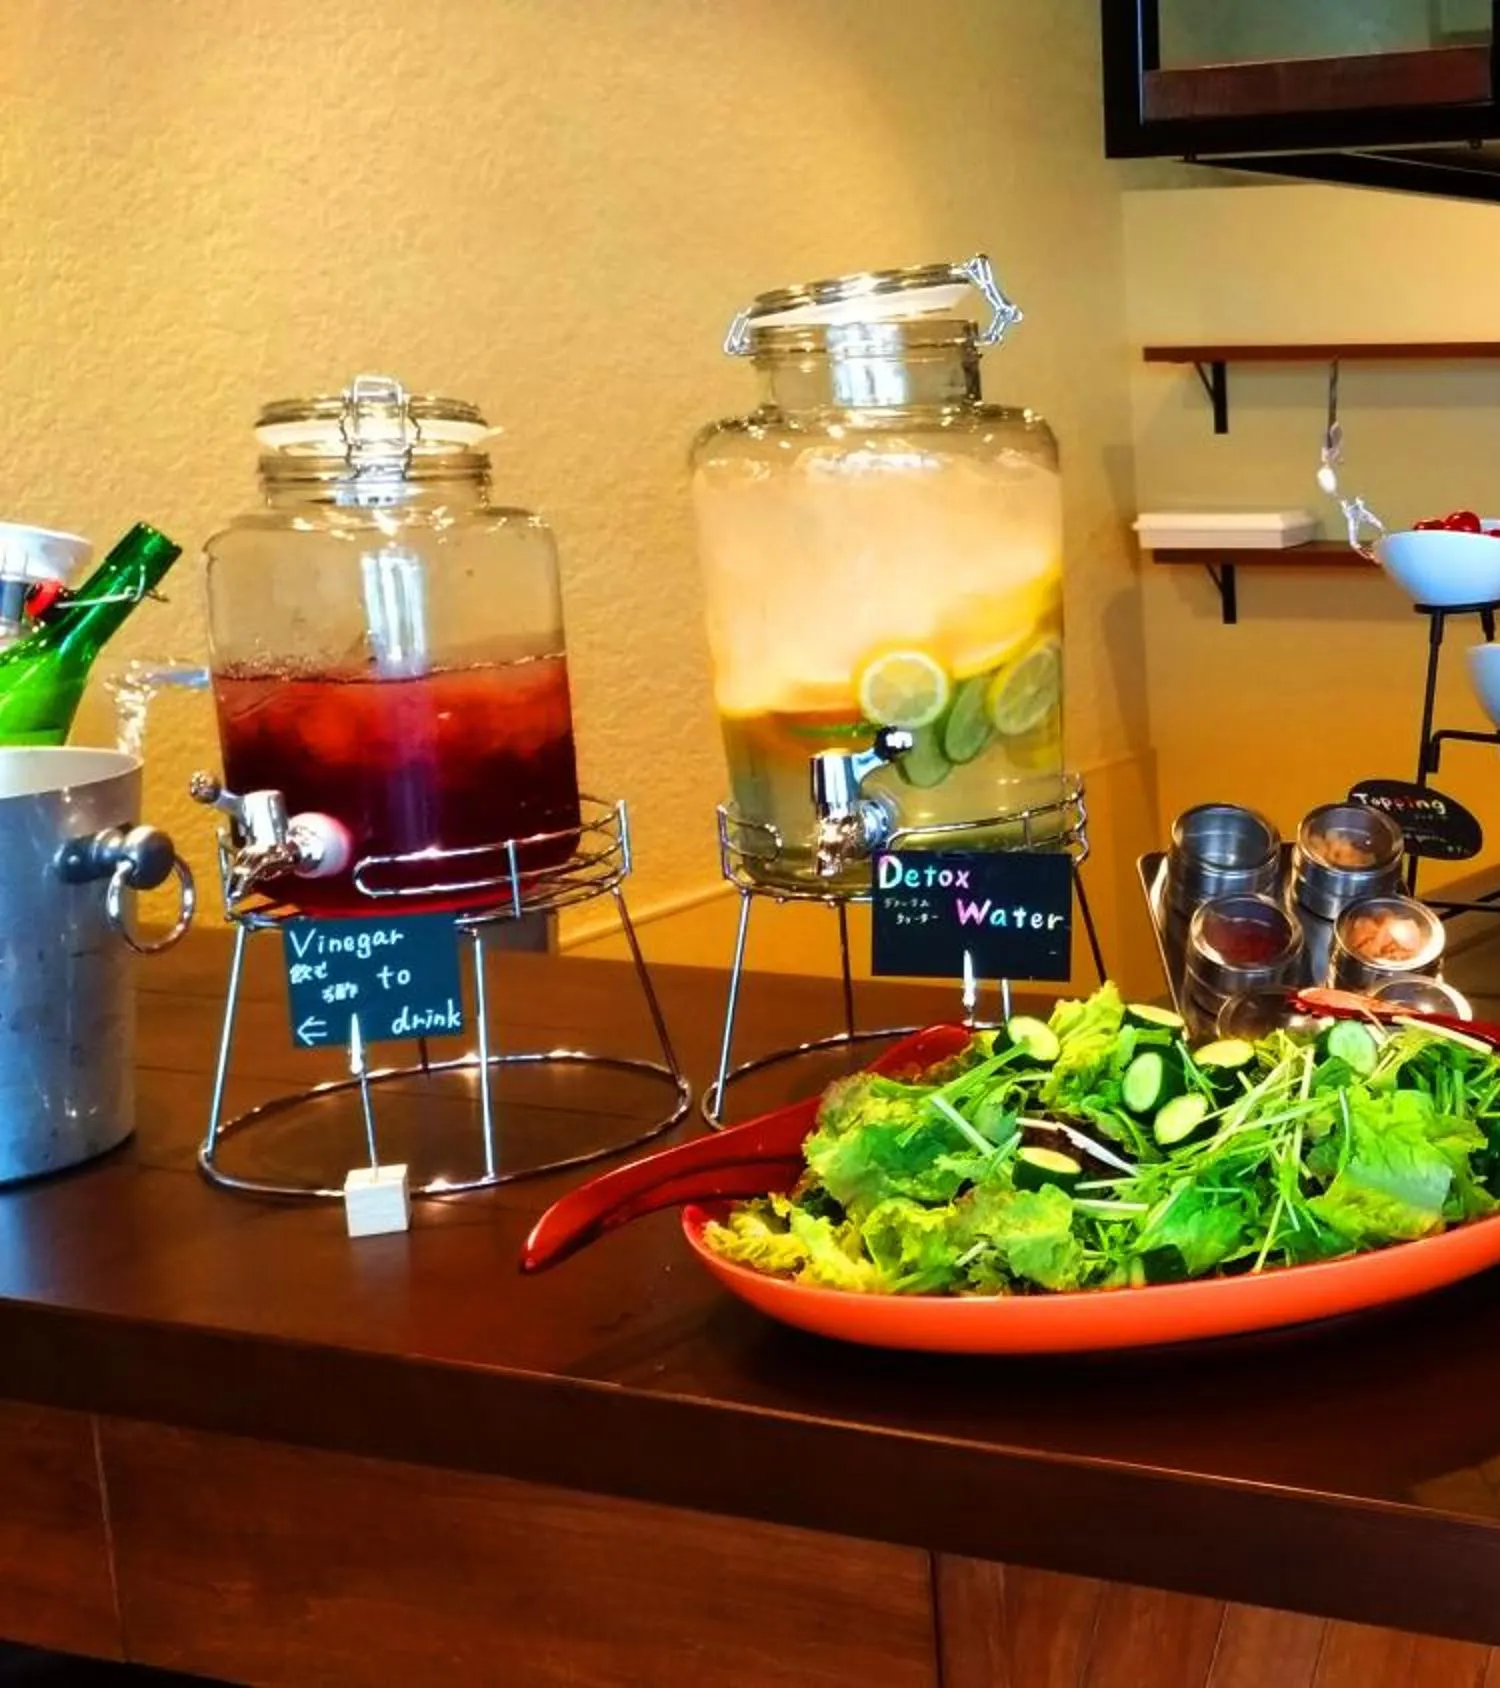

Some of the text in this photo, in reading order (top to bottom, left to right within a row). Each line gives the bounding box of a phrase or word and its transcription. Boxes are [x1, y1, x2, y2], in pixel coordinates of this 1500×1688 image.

[1352, 793, 1447, 815] Topping
[878, 854, 970, 890] Detox
[956, 898, 1065, 930] Water
[289, 928, 405, 960] Vinegar
[376, 965, 411, 990] to
[391, 998, 462, 1035] drink
